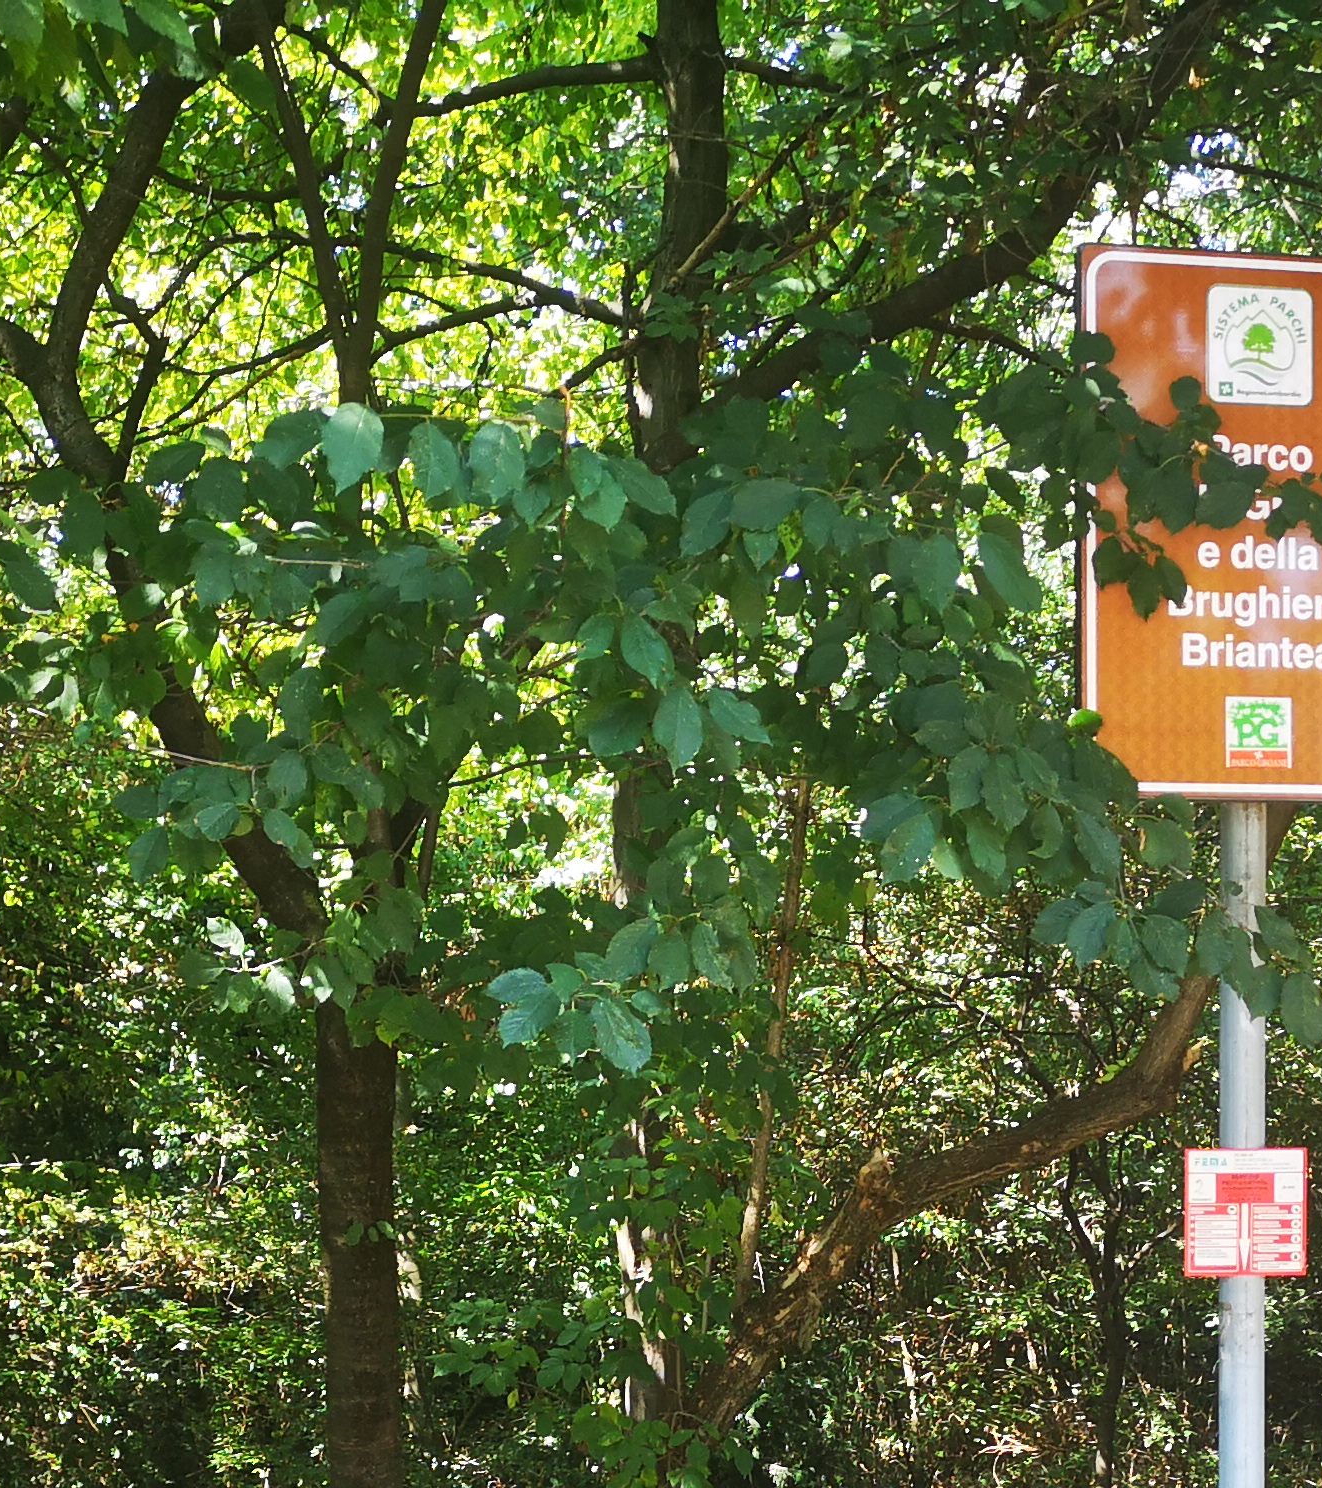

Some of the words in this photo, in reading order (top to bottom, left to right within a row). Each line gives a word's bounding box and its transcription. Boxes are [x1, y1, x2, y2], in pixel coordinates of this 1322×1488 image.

[1213, 294, 1259, 340] SISTEMA
[1270, 296, 1307, 343] PARCHI
[1197, 541, 1220, 568] e
[1230, 535, 1319, 571] della
